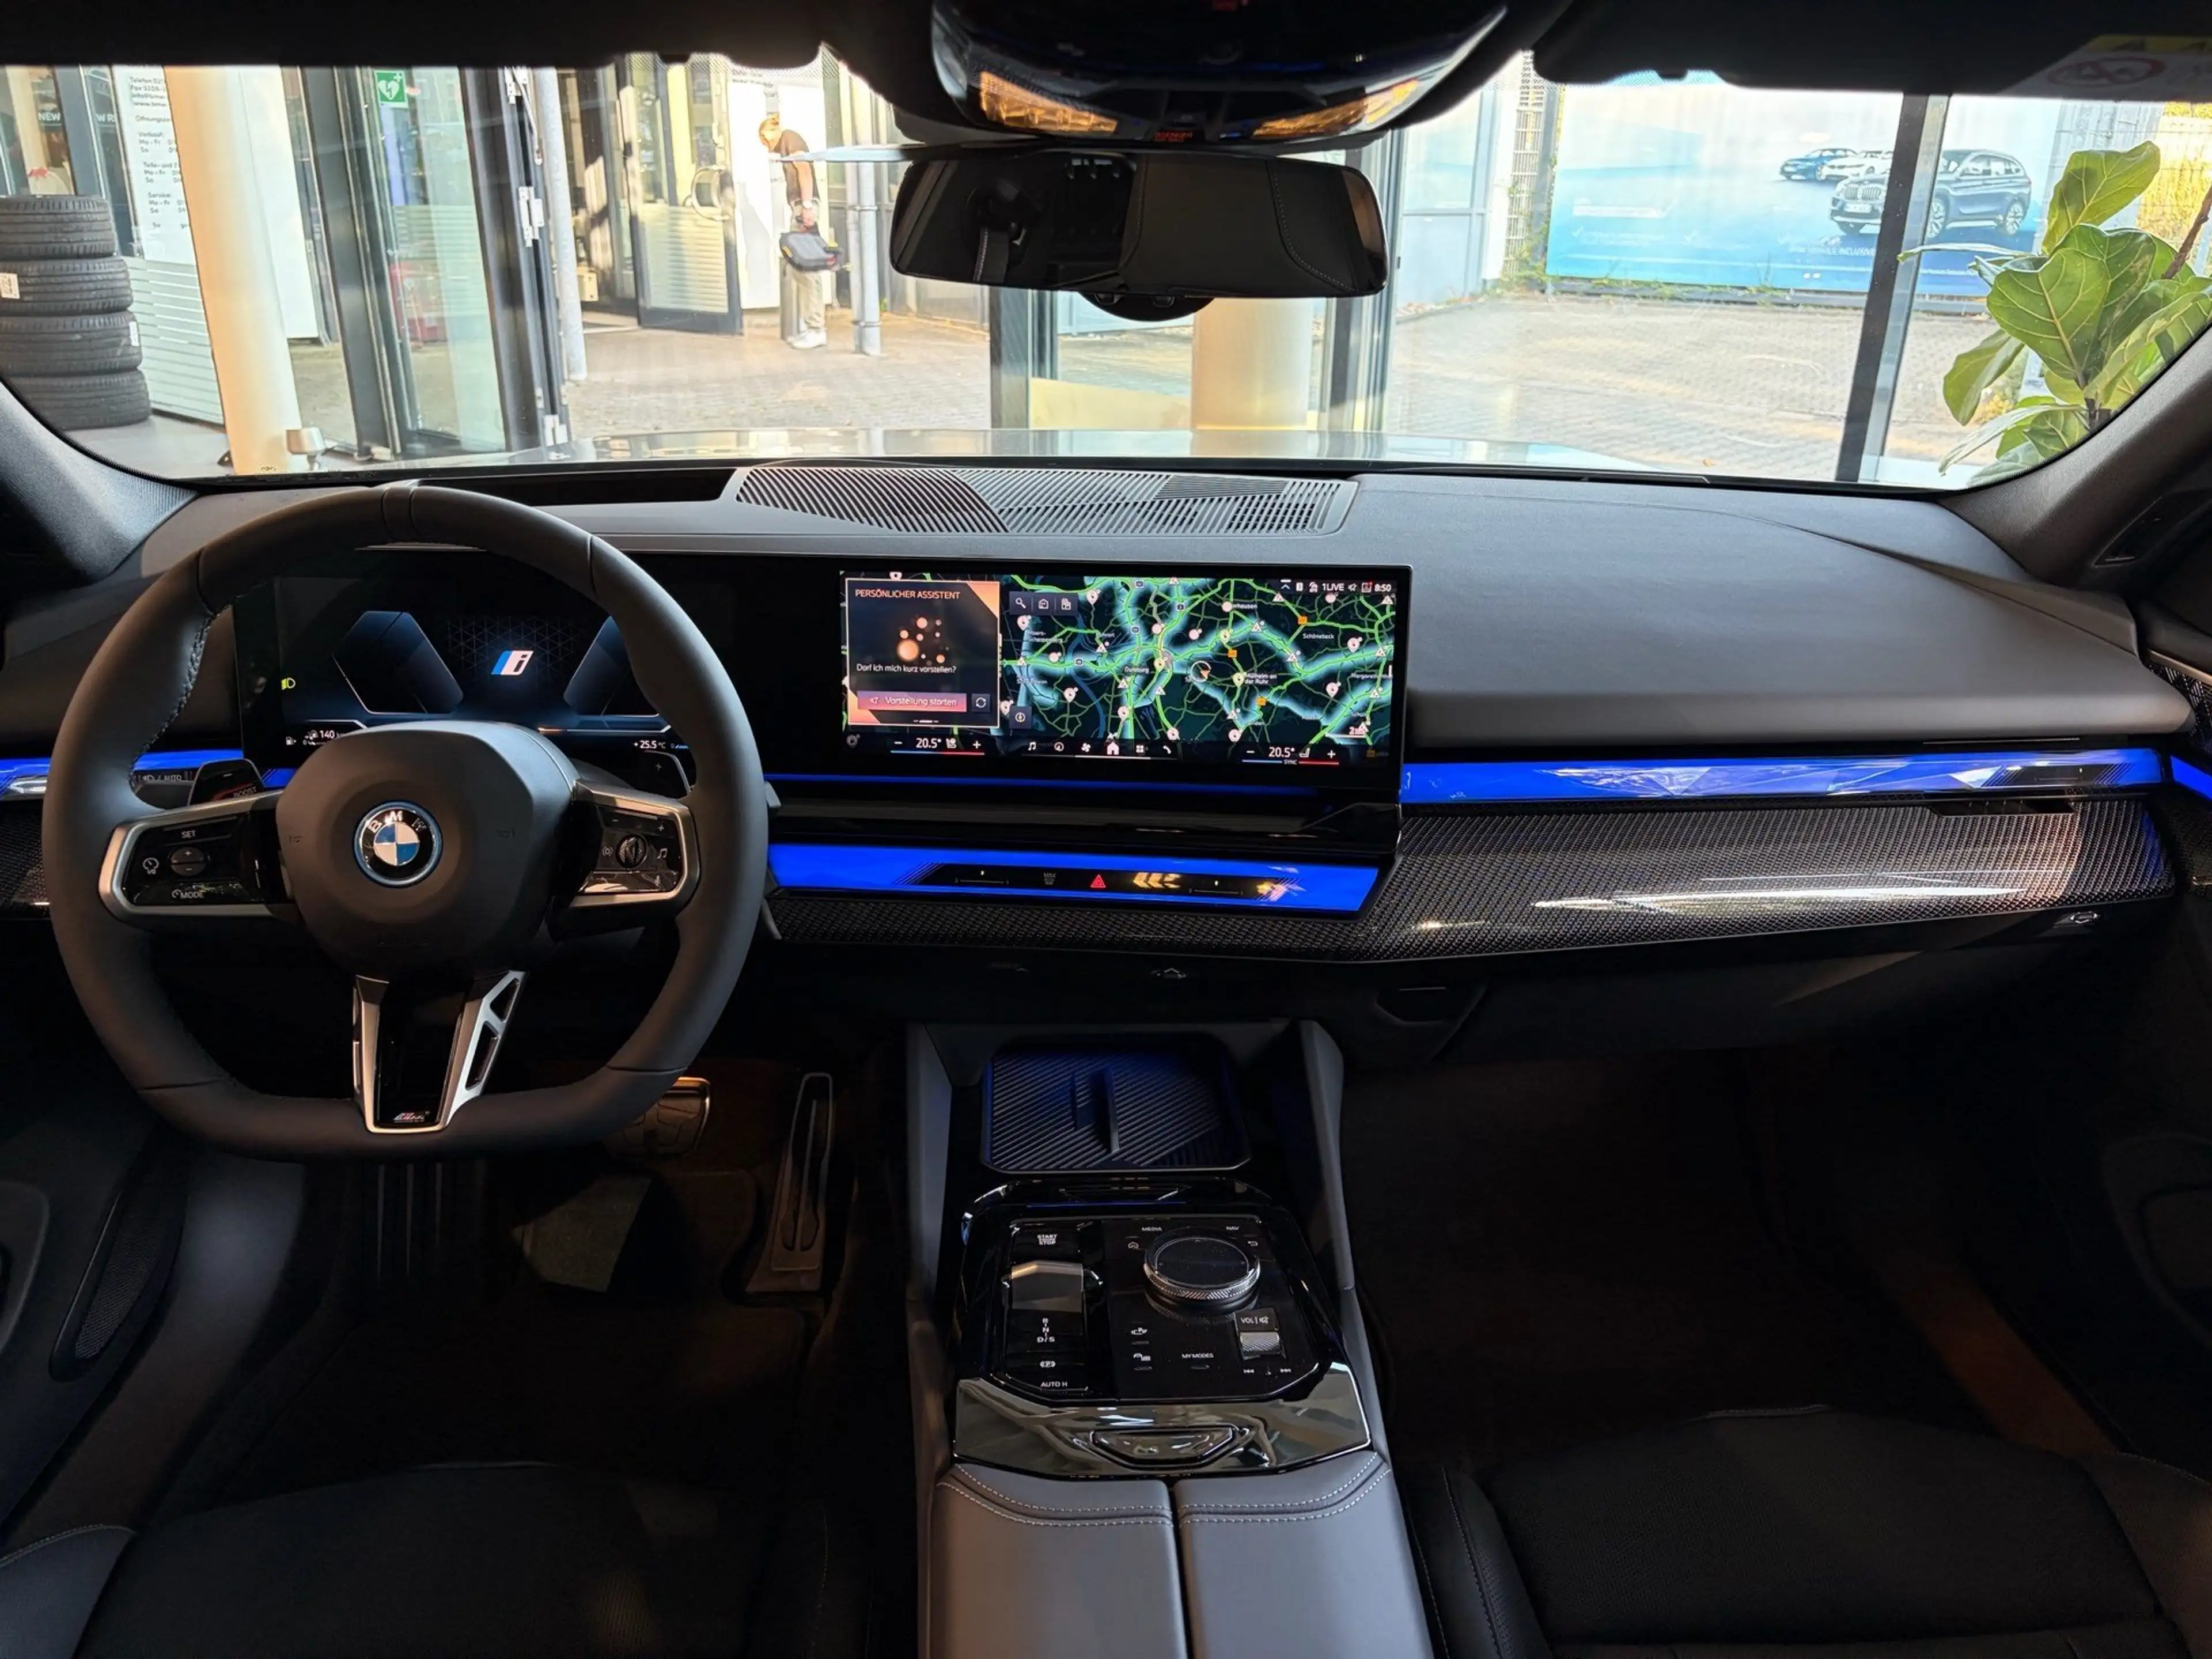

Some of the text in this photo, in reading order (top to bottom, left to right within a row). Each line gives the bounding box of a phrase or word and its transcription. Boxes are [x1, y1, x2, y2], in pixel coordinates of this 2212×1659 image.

[38, 112, 60, 121] NEW
[1322, 583, 1345, 592] 1LIVE
[1374, 584, 1392, 592] 8:50
[855, 589, 960, 599] PERSÖNLICHER ASSISTENT
[857, 664, 872, 672] Darf
[885, 664, 902, 673] mich
[903, 664, 918, 673] kurz
[919, 665, 957, 673] vorstellen?
[885, 697, 957, 706] Vorstellung starten
[320, 730, 335, 739] 140
[367, 810, 427, 834] BMW
[181, 830, 196, 838] SET
